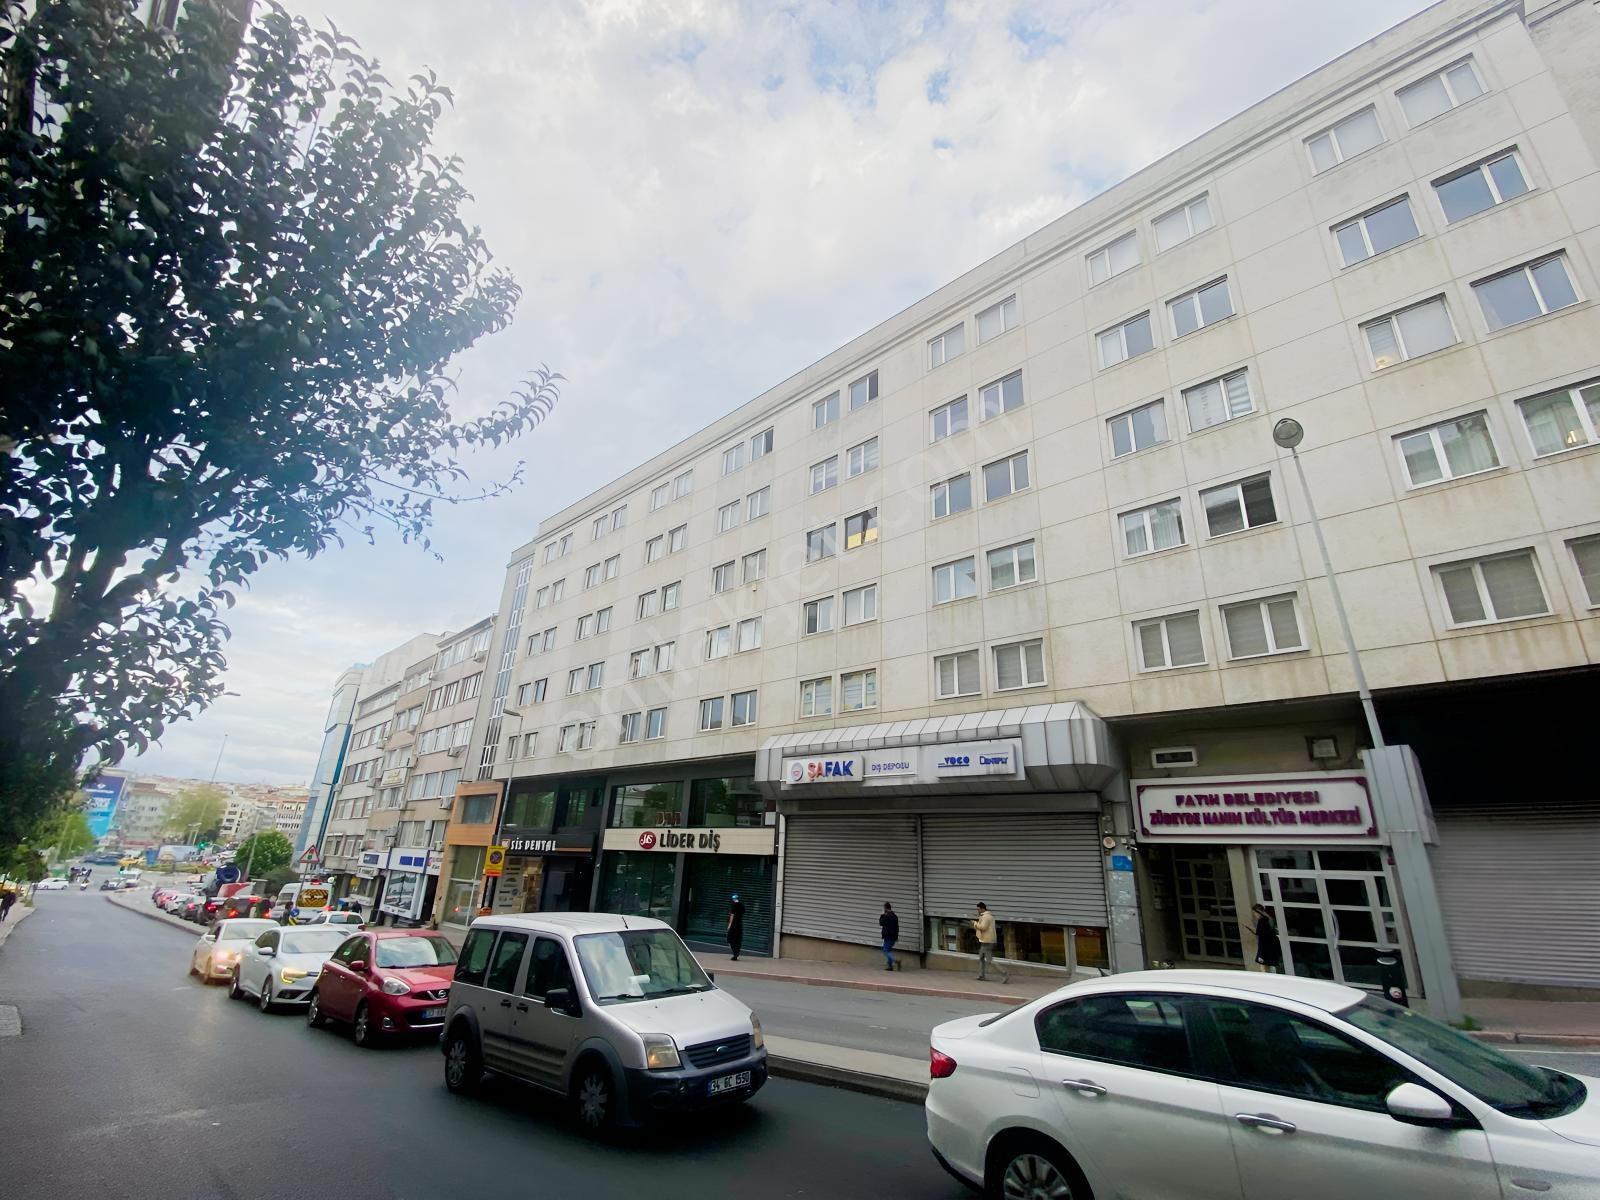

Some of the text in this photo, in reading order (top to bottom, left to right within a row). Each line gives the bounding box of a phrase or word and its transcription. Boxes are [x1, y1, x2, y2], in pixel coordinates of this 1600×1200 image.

[807, 760, 854, 782] ŞAFAK
[1245, 807, 1297, 825] KÜLTÜR
[510, 837, 556, 851] SİS DENTAL
[659, 829, 695, 848] LİDER
[699, 829, 721, 852] DİŞ
[711, 1079, 720, 1091] 34
